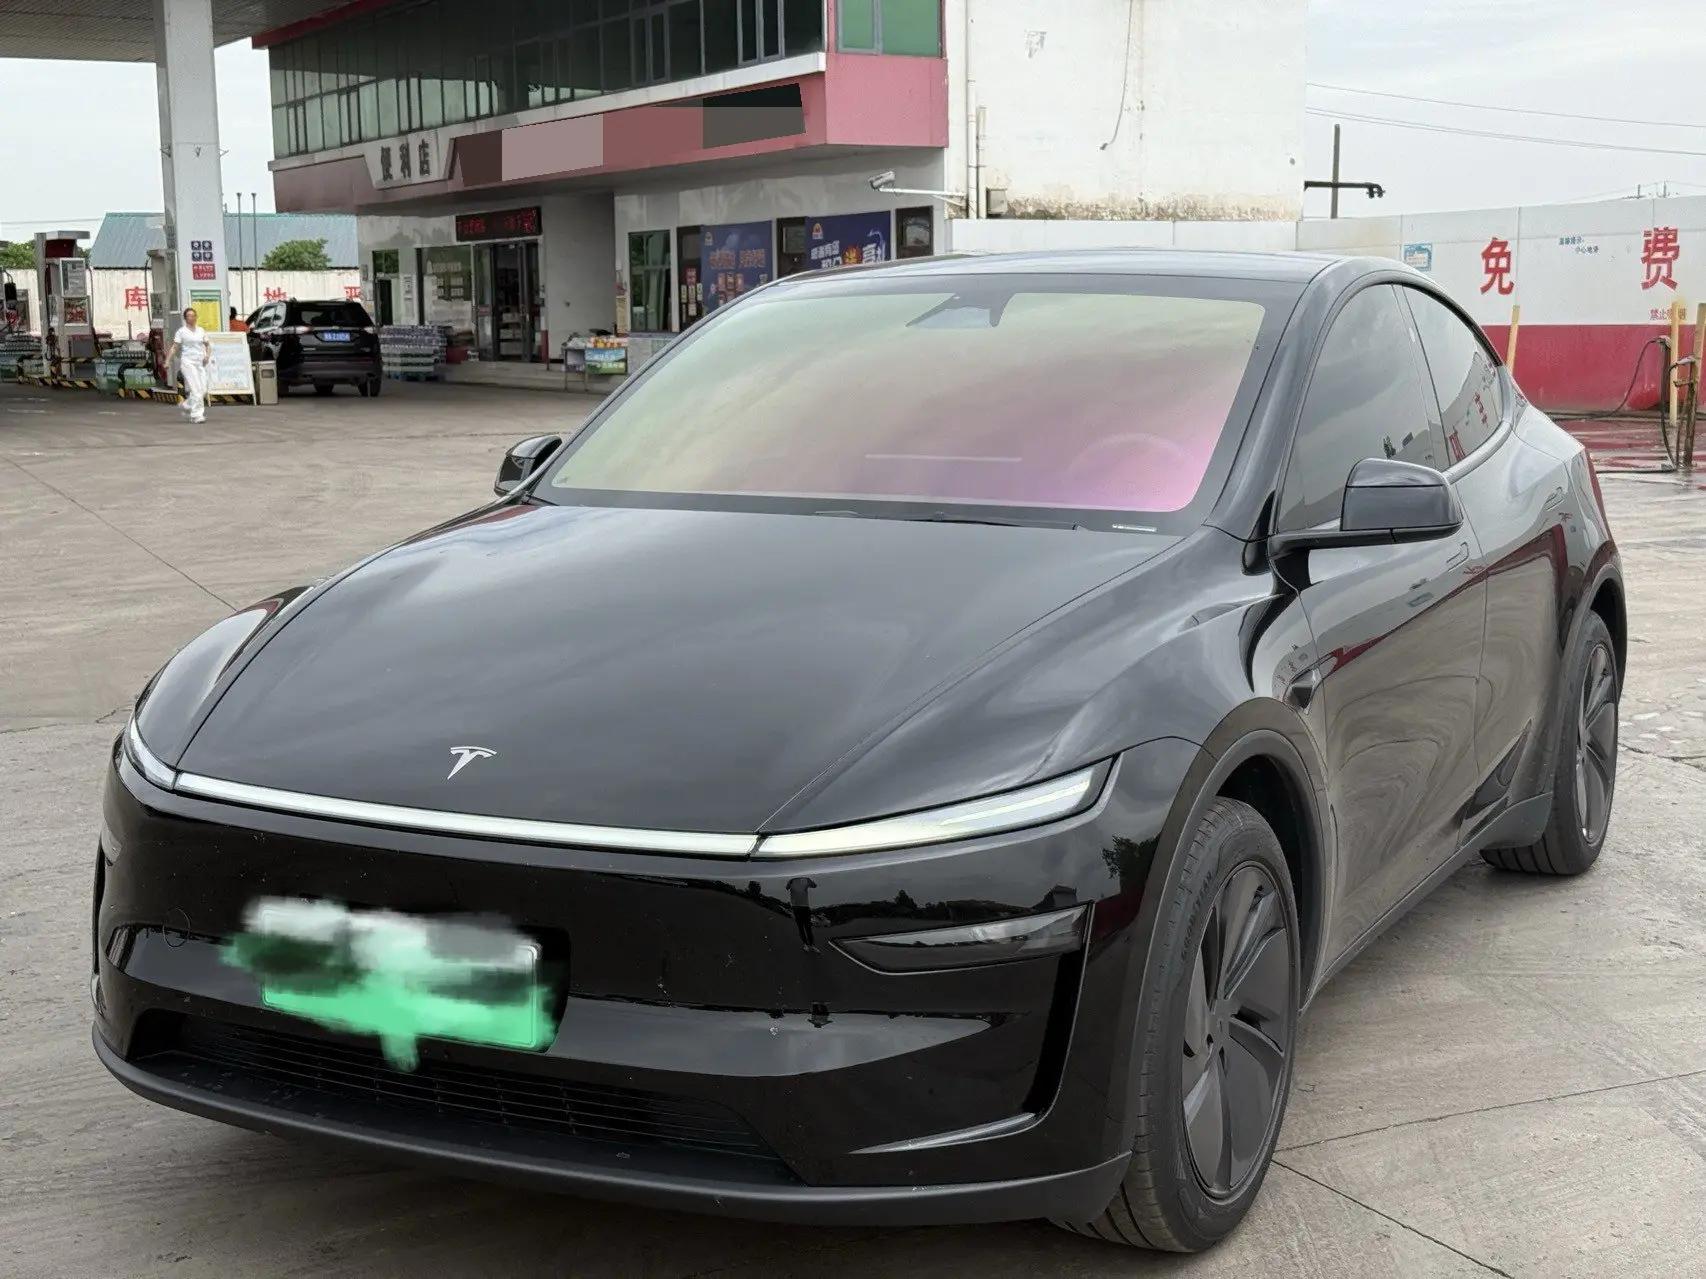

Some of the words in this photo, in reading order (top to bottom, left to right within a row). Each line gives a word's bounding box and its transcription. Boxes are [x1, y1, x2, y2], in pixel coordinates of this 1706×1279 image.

[382, 139, 429, 181] 便利店
[1480, 237, 1515, 296] 免
[1641, 226, 1680, 291] 费
